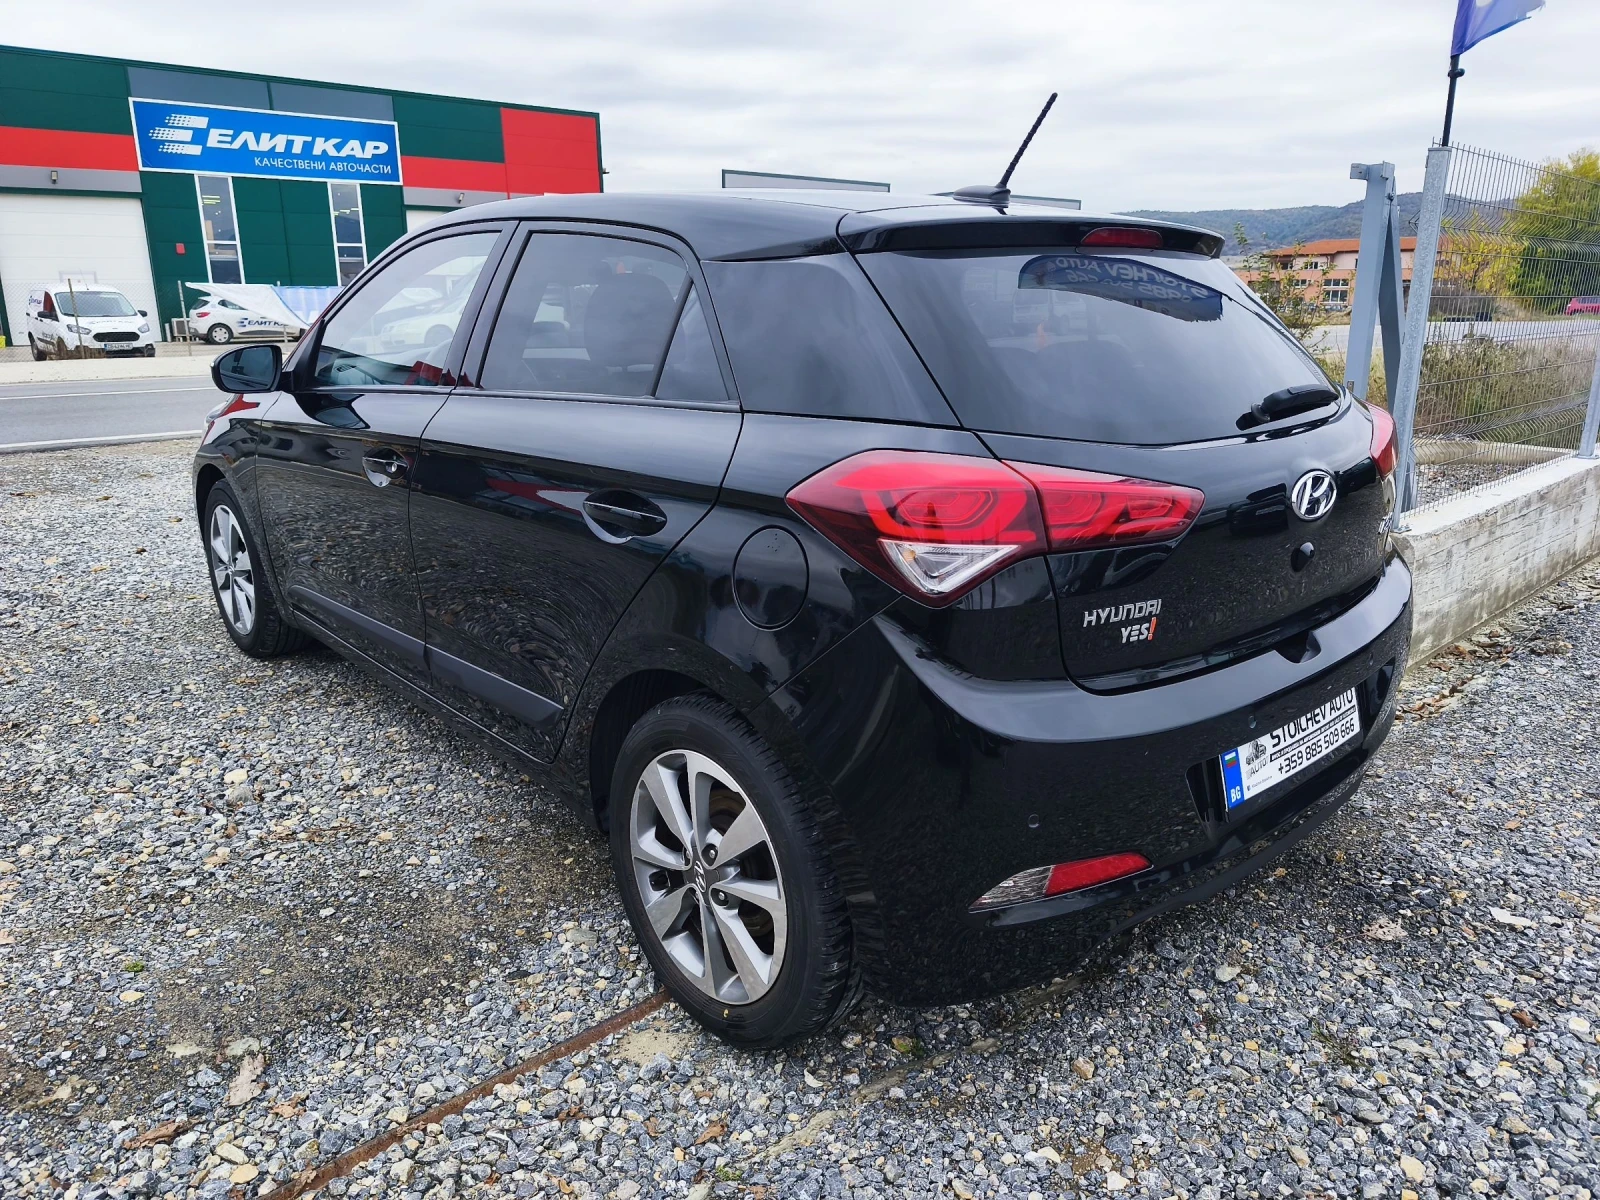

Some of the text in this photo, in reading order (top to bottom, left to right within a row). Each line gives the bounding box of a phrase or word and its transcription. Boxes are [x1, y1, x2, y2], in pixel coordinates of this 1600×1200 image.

[254, 156, 392, 174] КАЧЕСТВЕНИ АВТОЧАСТИ
[1083, 599, 1162, 628] HYUNDAI
[1121, 616, 1157, 643] YES!
[1270, 704, 1326, 748] STOICHEV
[1329, 688, 1354, 717] AUTO
[1278, 750, 1304, 775] +359
[1305, 738, 1323, 761] 885
[1324, 728, 1340, 750] 509
[1340, 717, 1355, 739] 666
[1230, 785, 1242, 804] BG
